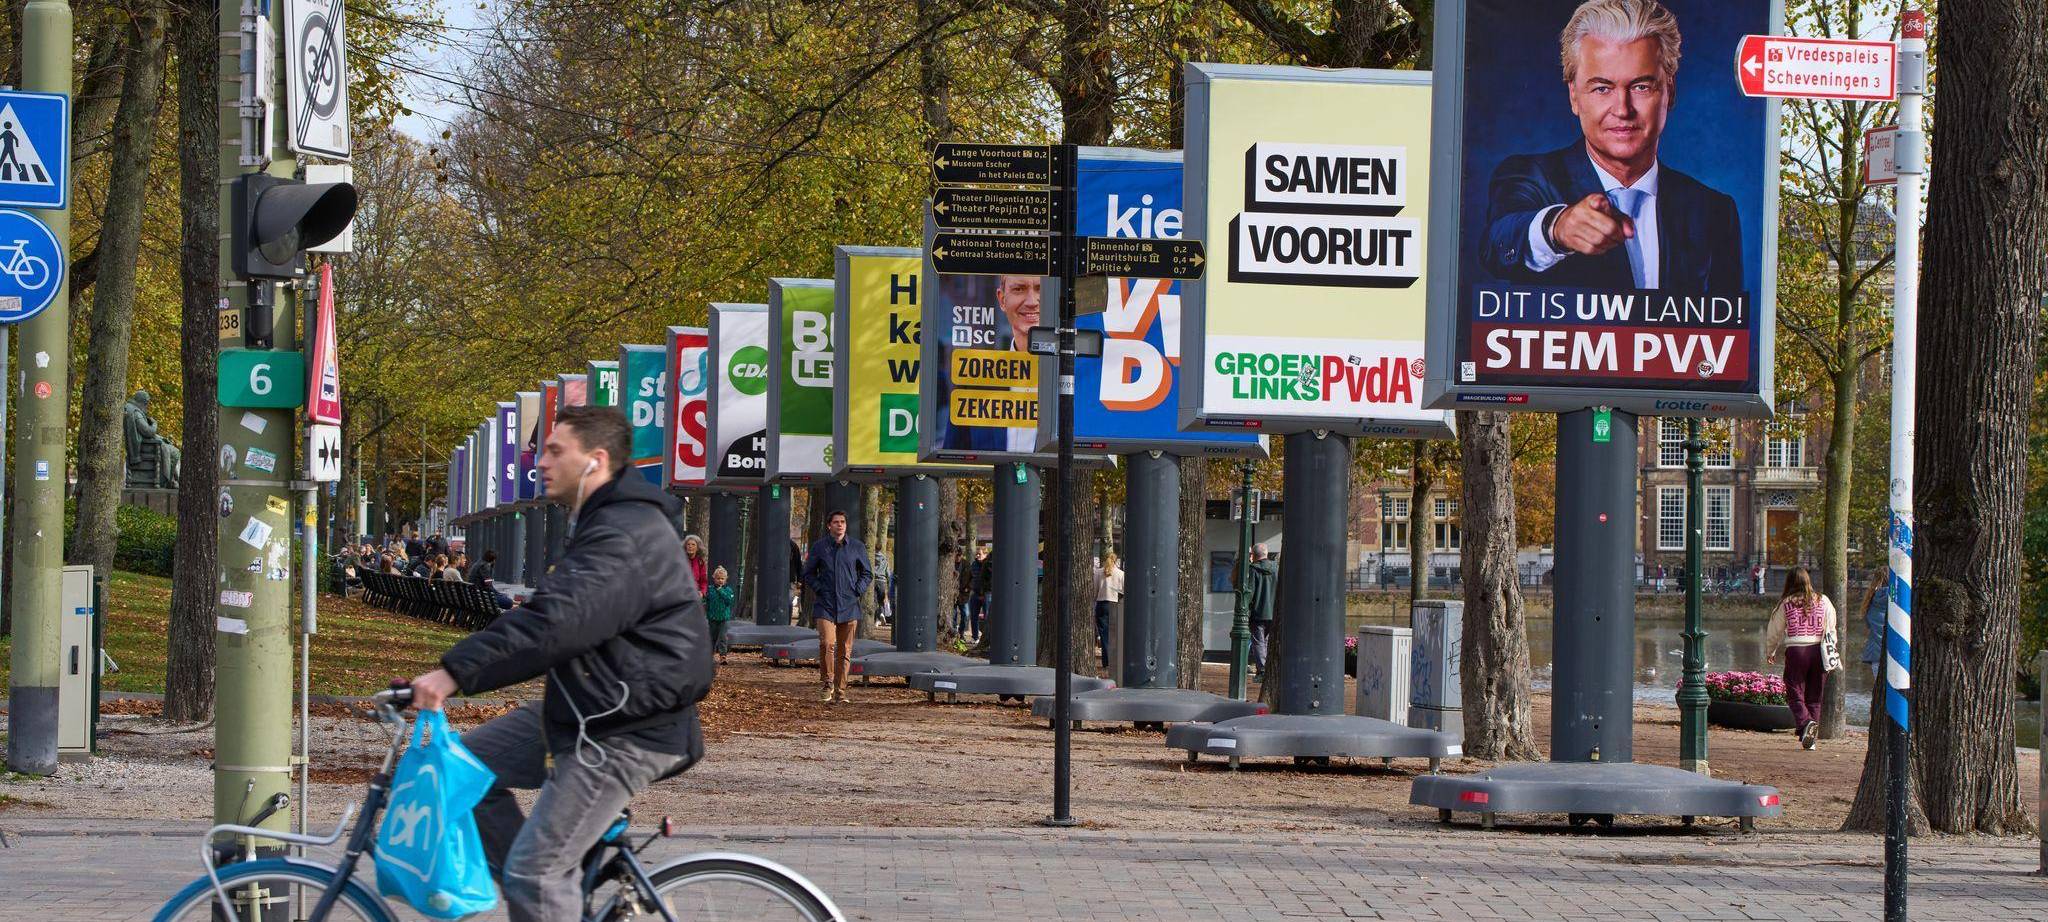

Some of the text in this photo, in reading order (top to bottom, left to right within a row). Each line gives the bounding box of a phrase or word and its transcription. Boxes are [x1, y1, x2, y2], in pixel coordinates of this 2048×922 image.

[1787, 46, 1879, 64] Vredespaleis
[1768, 70, 1880, 90] Scheveningen 3
[952, 148, 978, 158] Lange
[980, 149, 1020, 158] Voorhout
[1265, 154, 1397, 196] SAMEN
[984, 194, 1024, 204] Diligentia
[952, 204, 986, 212] Theater
[990, 205, 1018, 215] Pepijn
[995, 240, 1023, 248] Toneel
[1090, 242, 1140, 251] Binnenhof
[1248, 224, 1412, 266] VOORUIT
[1090, 253, 1147, 262] Mauritshuis
[1090, 264, 1122, 272] Politie
[952, 306, 994, 326] STEM
[1479, 290, 1742, 324] DIT IS UW LAND!
[1486, 328, 1618, 372] STEM
[1634, 332, 1736, 374] PVV
[958, 358, 1031, 380] ZORGEN
[1214, 352, 1320, 378] GROEN
[250, 363, 272, 396] 6
[1232, 377, 1320, 401] LINKS
[1322, 356, 1413, 404] PvdA
[1656, 400, 1709, 410] trotter
[728, 454, 766, 468] Bon
